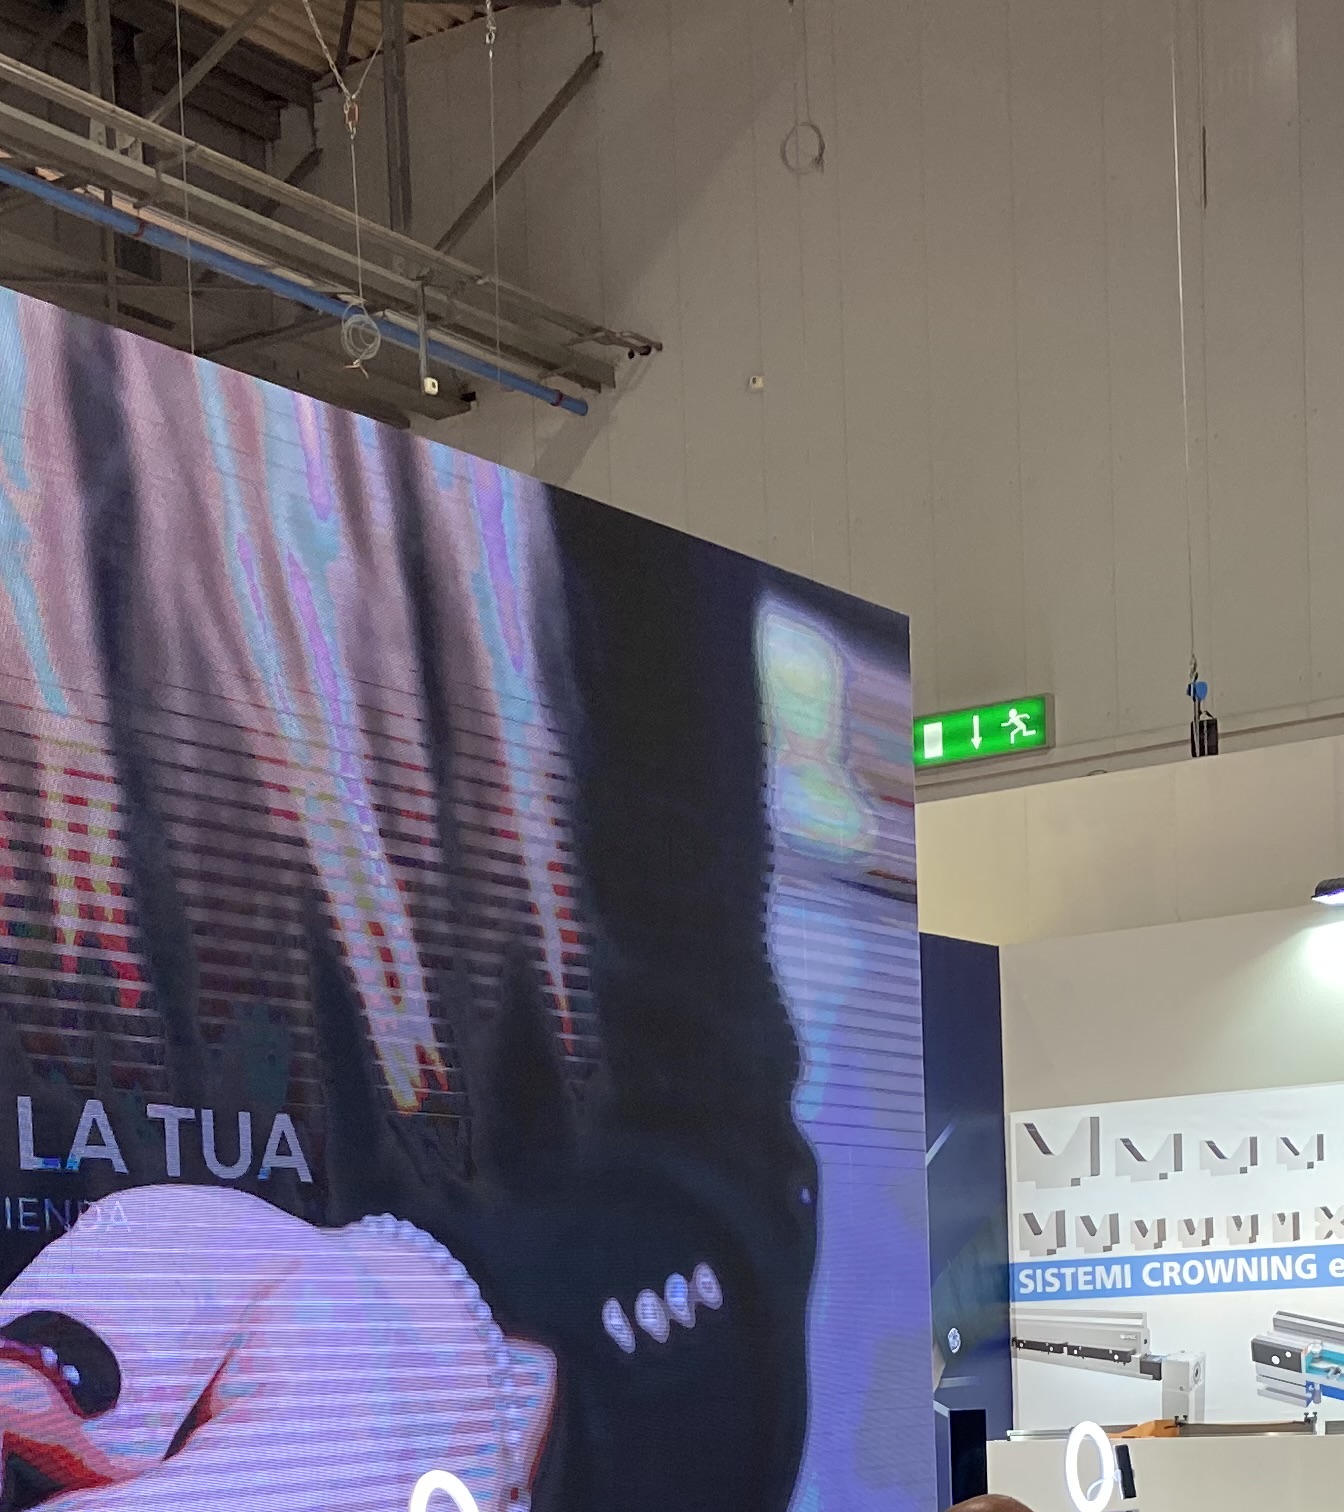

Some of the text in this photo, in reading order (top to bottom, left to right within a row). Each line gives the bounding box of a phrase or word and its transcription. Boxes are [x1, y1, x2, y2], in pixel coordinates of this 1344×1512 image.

[17, 1096, 129, 1176] LA
[146, 1103, 314, 1184] TUA
[1018, 1263, 1132, 1295] SISTEMI
[1142, 1253, 1317, 1288] CROWNING
